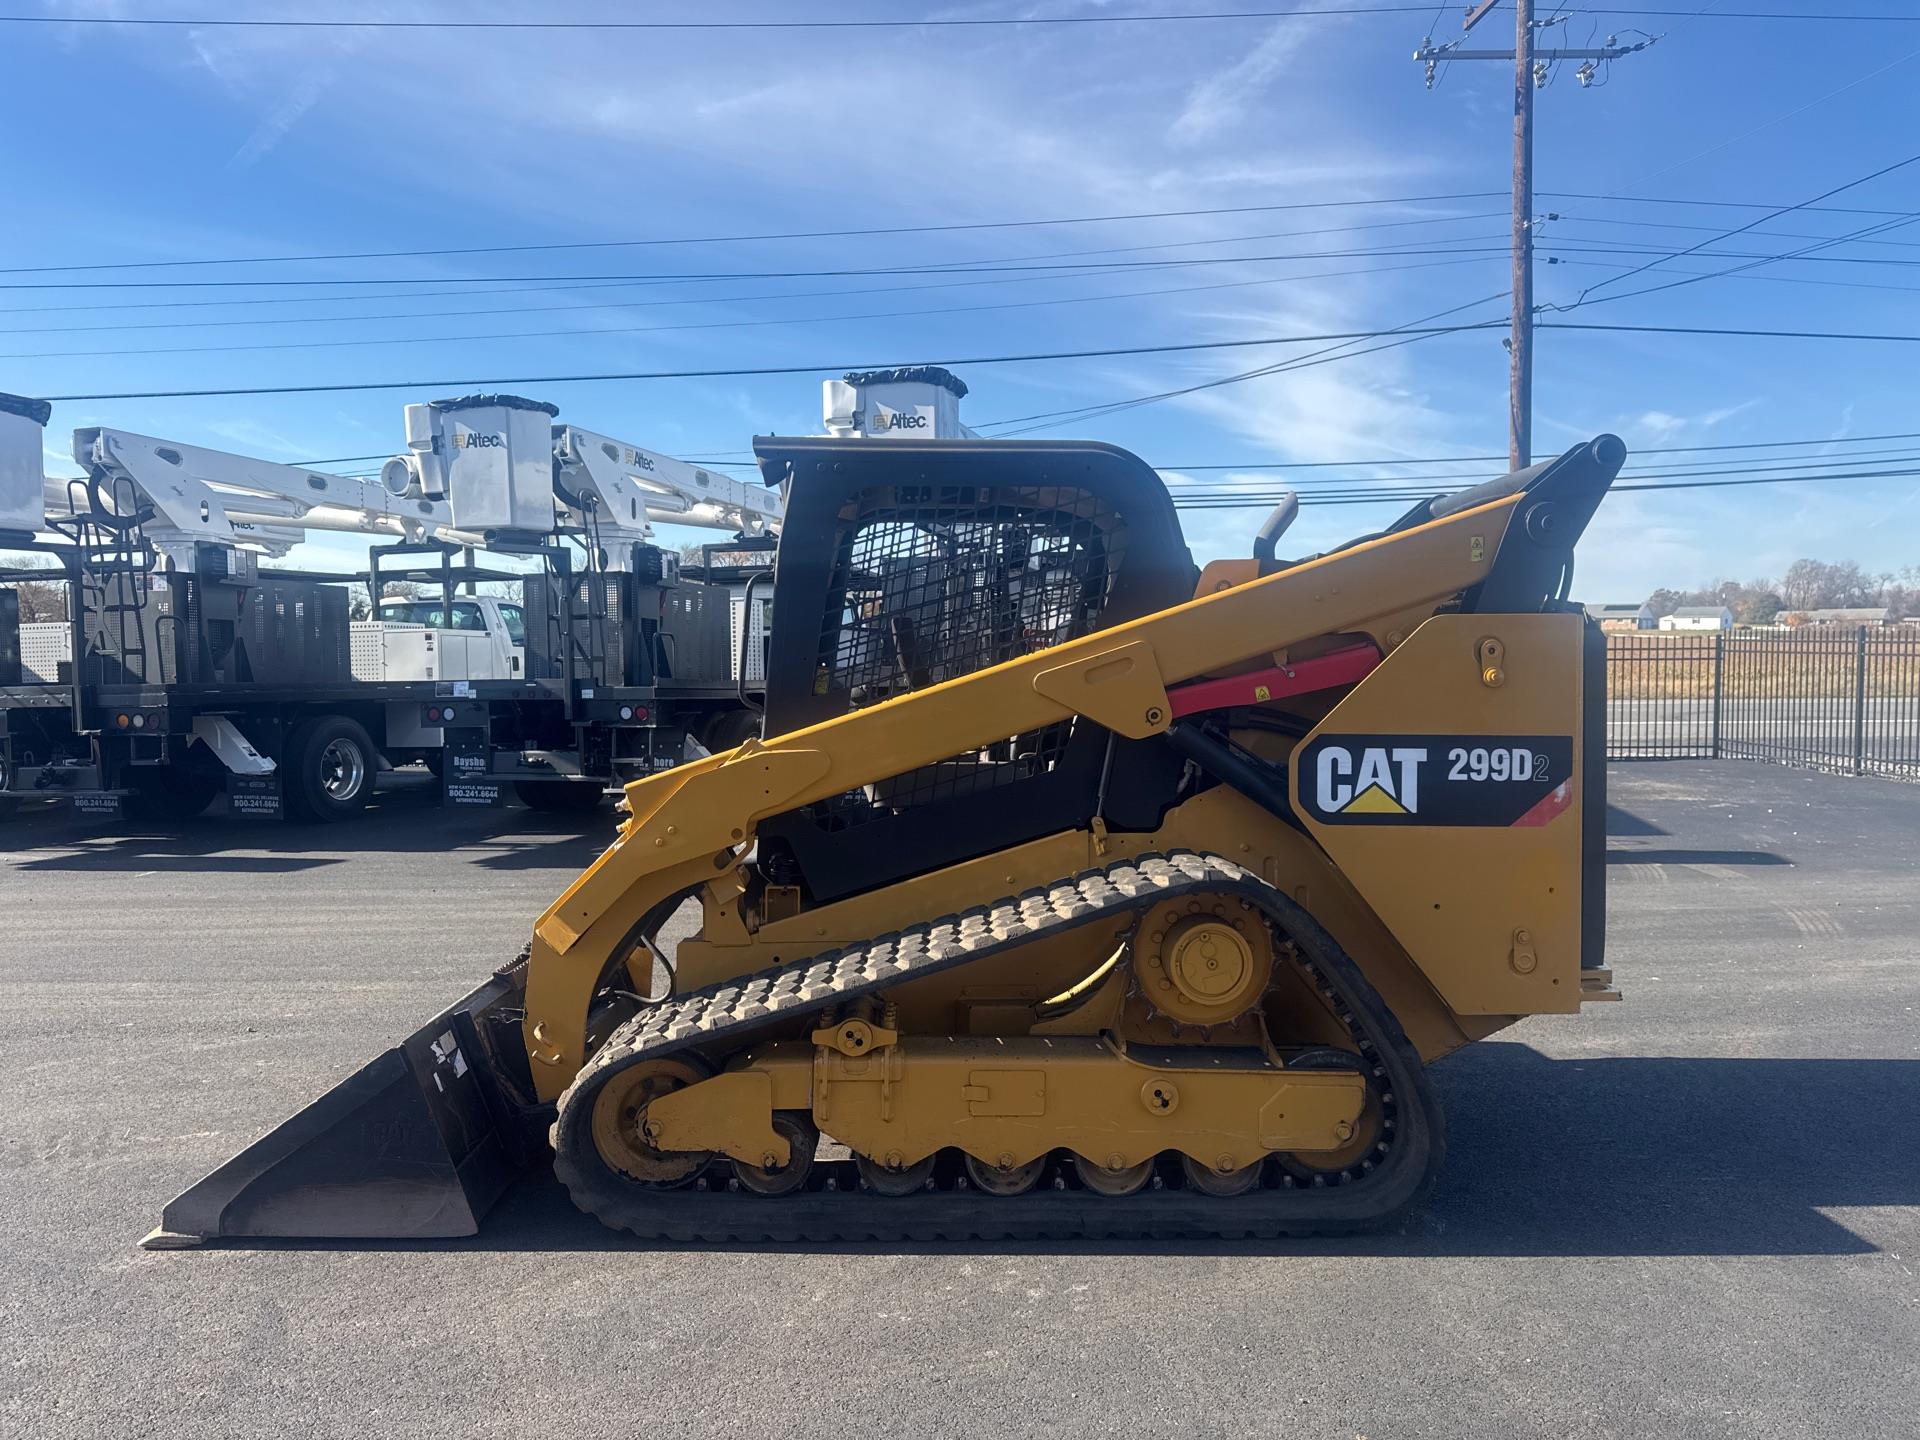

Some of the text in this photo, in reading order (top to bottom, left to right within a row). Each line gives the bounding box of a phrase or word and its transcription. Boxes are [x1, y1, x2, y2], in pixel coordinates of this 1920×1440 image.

[887, 413, 927, 429] Altec
[466, 433, 501, 448] Altec
[634, 451, 655, 471] Altec
[1448, 748, 1549, 781] 299D2
[1317, 746, 1427, 813] CAT
